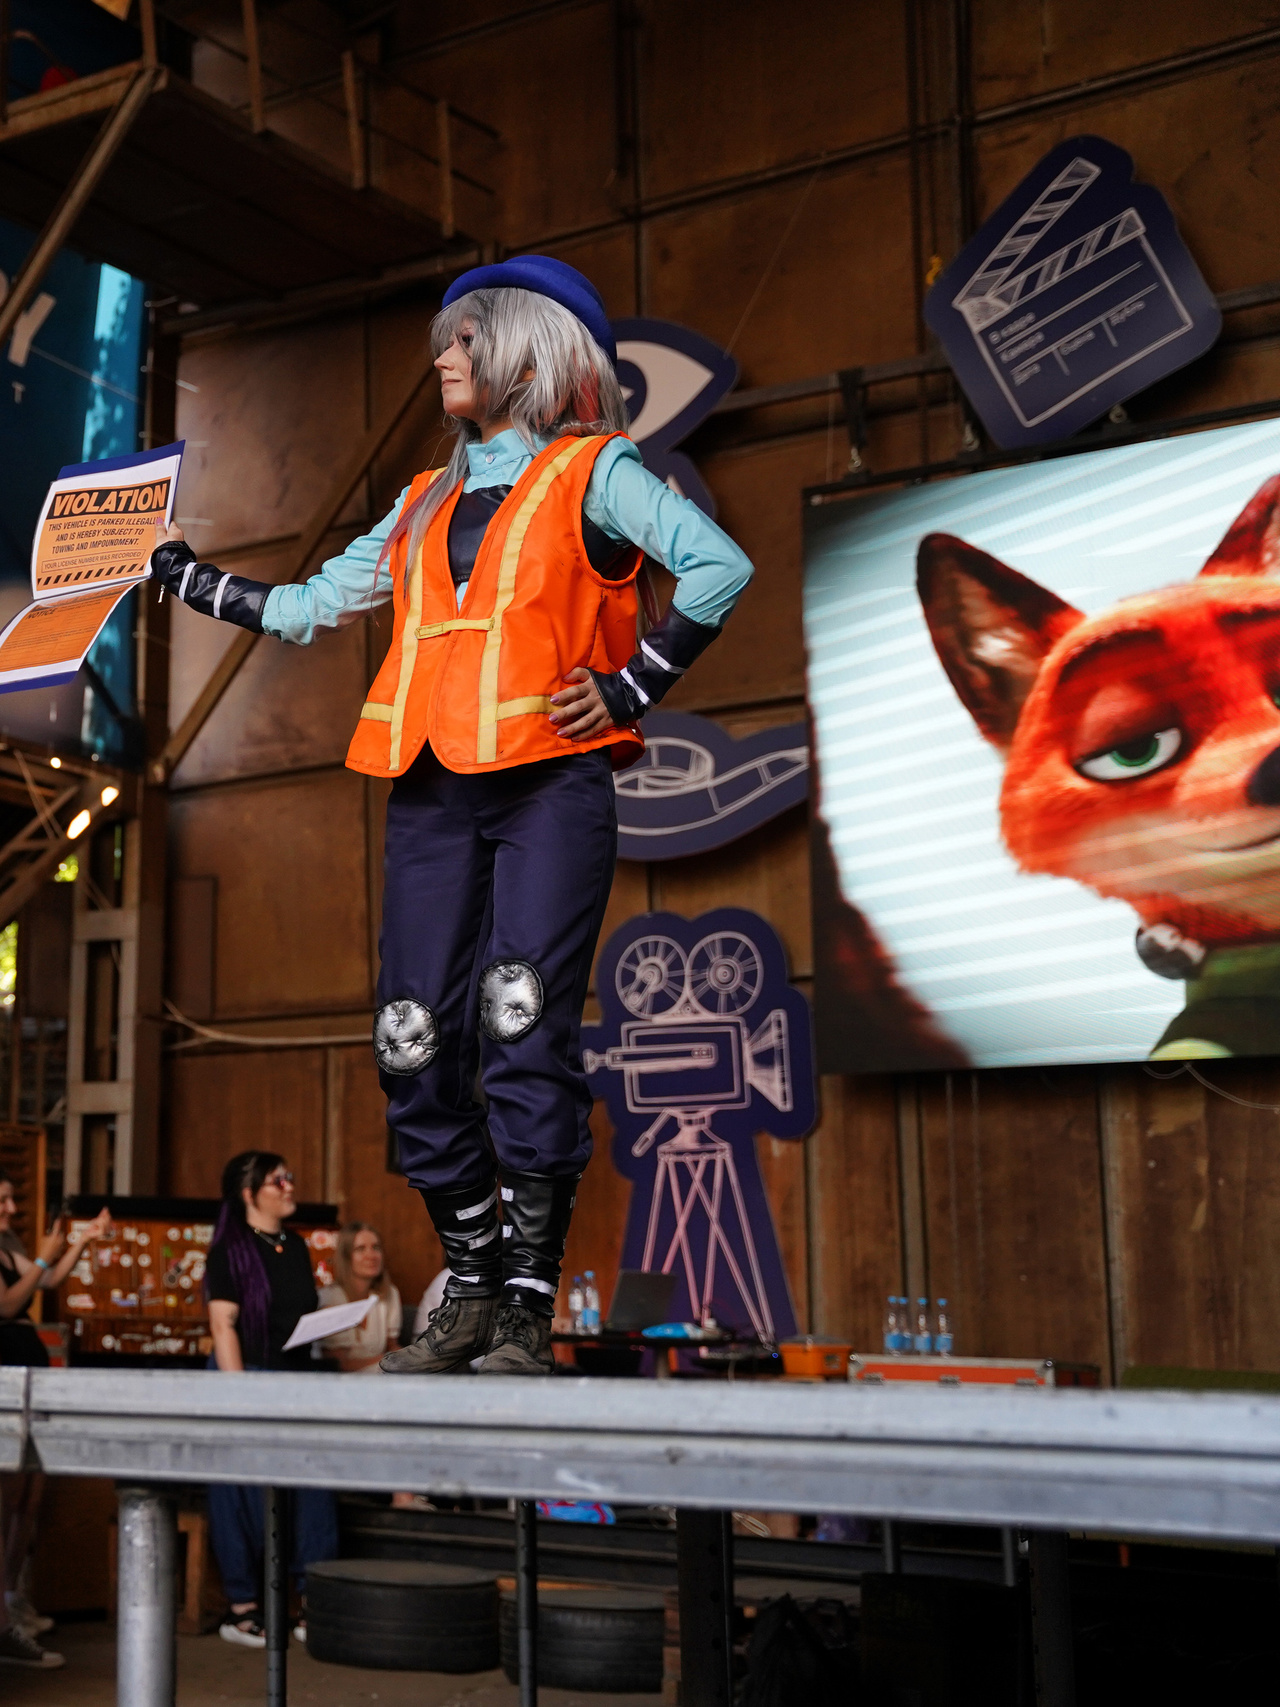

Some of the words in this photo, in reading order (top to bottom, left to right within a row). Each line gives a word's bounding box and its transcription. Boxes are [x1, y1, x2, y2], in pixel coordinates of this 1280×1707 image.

[53, 483, 167, 517] VIOLATION
[48, 521, 62, 531] THIS
[63, 519, 88, 530] VEHICLE
[89, 519, 96, 527] IS
[97, 517, 124, 526] PARKED
[126, 516, 160, 525] ILLEGALL
[56, 533, 68, 542] AND
[69, 532, 76, 540] IS
[77, 529, 101, 540] HEREBY
[102, 528, 133, 536] SUBJECT
[52, 544, 74, 554] TOWING
[75, 543, 88, 552] AND
[89, 538, 139, 549] IMPOUNDMENT.
[44, 562, 57, 570] YOUR
[57, 559, 78, 568] LICENSE
[78, 556, 99, 566] NUMBER
[111, 551, 141, 560] RECORDED
[26, 608, 56, 619] NOTICE
